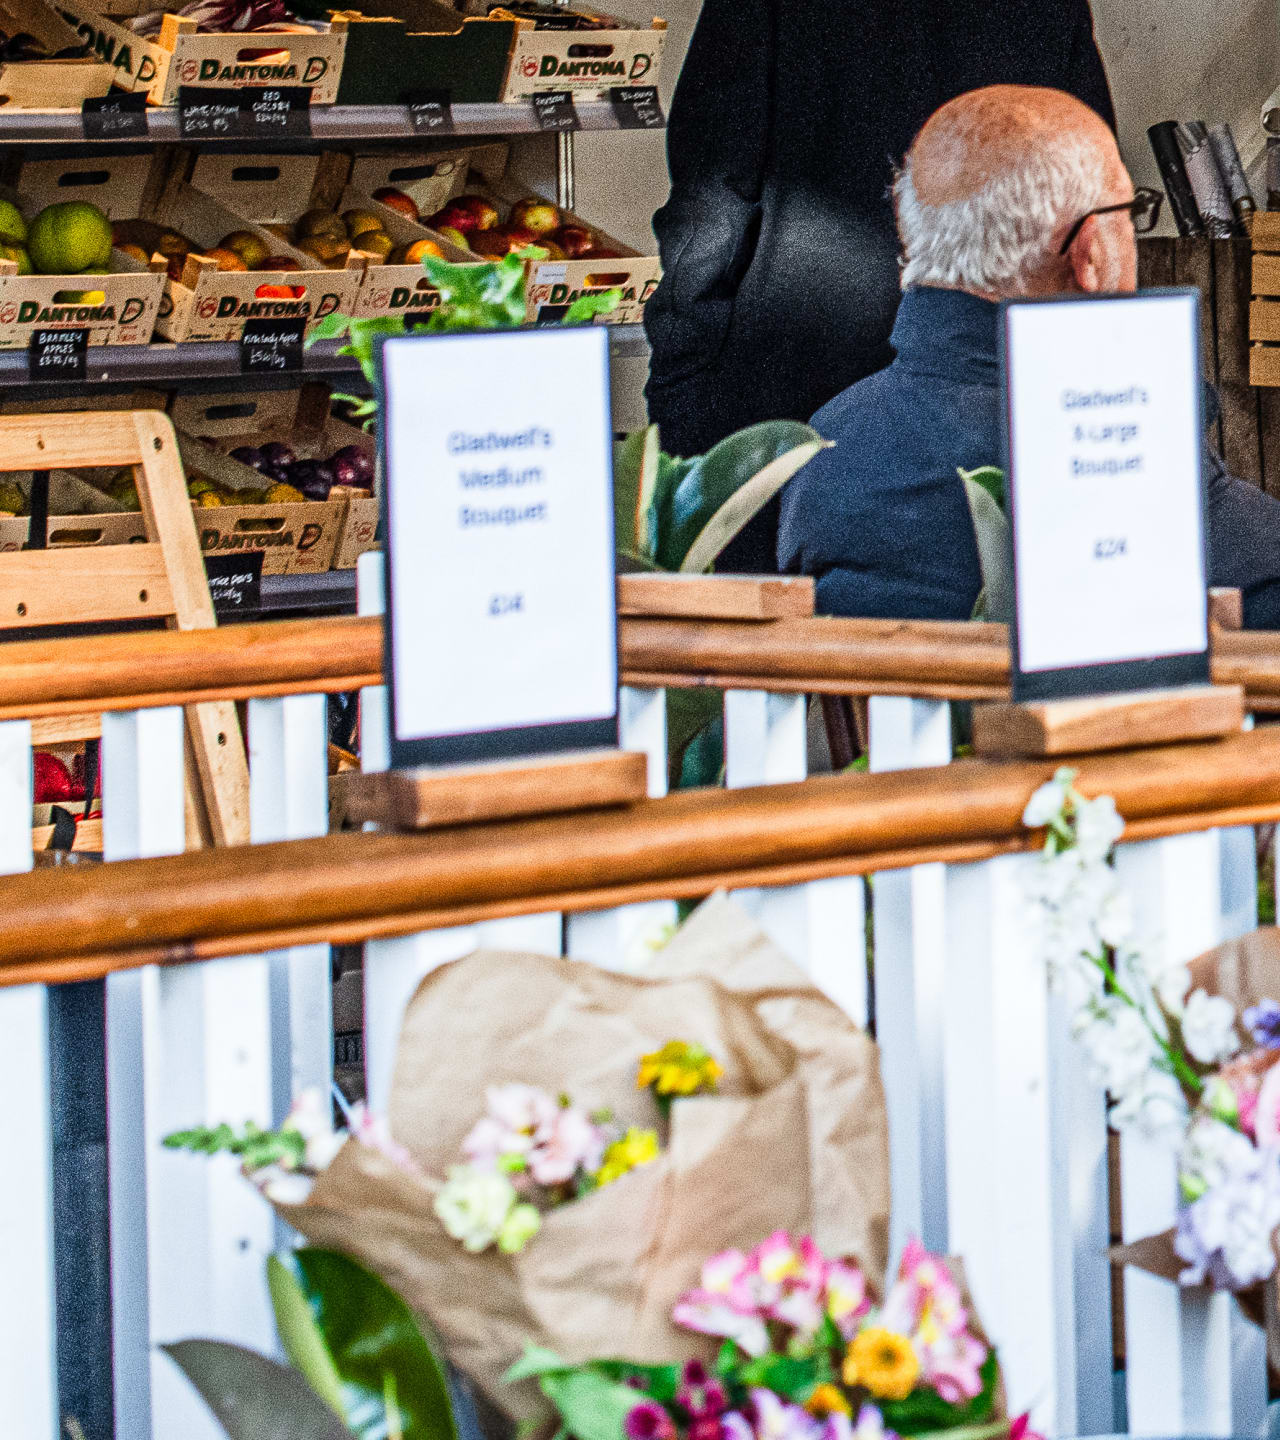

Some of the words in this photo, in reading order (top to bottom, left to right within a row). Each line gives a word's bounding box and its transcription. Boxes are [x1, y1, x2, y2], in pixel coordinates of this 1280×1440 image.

[39, 331, 82, 343] BRAMLEY
[43, 344, 74, 355] APPLES
[1071, 455, 1143, 478] Bouquet
[460, 467, 543, 490] Medium
[460, 502, 547, 529] Bouquet
